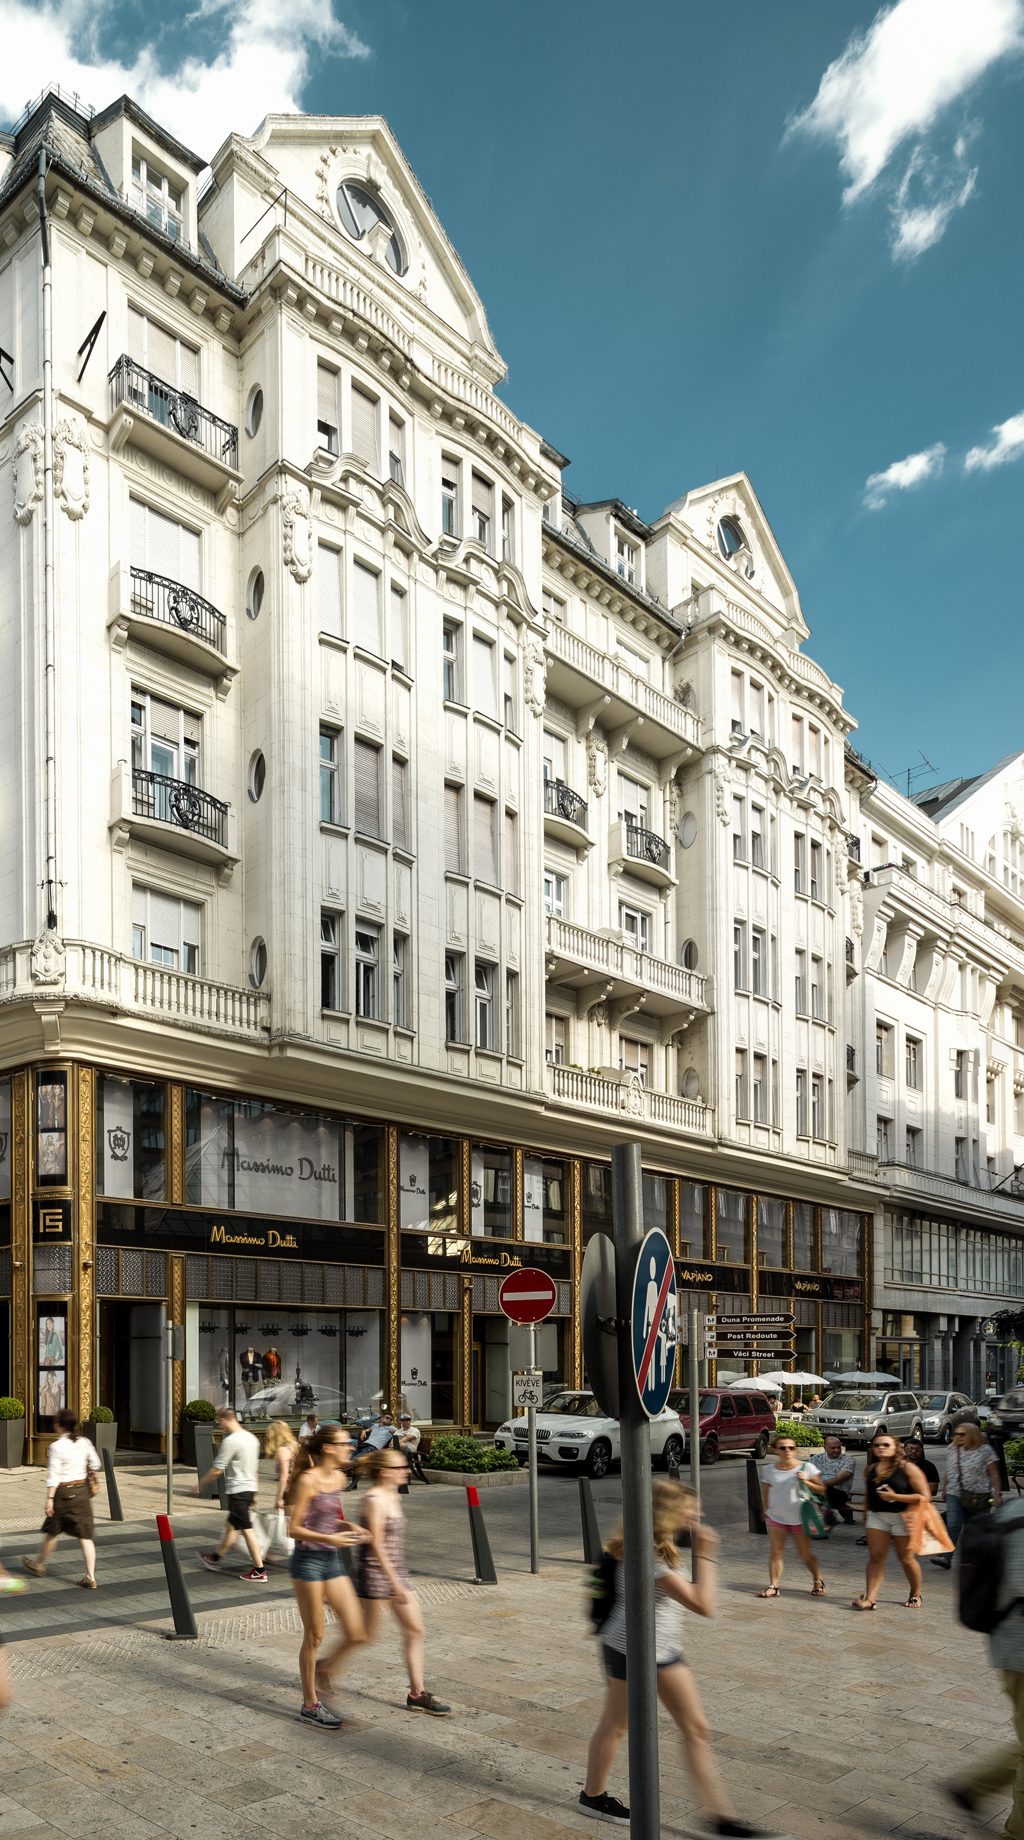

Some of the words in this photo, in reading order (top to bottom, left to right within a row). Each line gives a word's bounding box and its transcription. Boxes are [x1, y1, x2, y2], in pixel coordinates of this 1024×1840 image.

[221, 1146, 294, 1177] Massimo
[297, 1157, 338, 1183] Dutti
[209, 1225, 266, 1246] Massimo
[266, 1230, 299, 1249] Dutti
[460, 1249, 500, 1267] Massimo
[500, 1252, 523, 1268] Dutti
[515, 1377, 541, 1388] KIVÉVE
